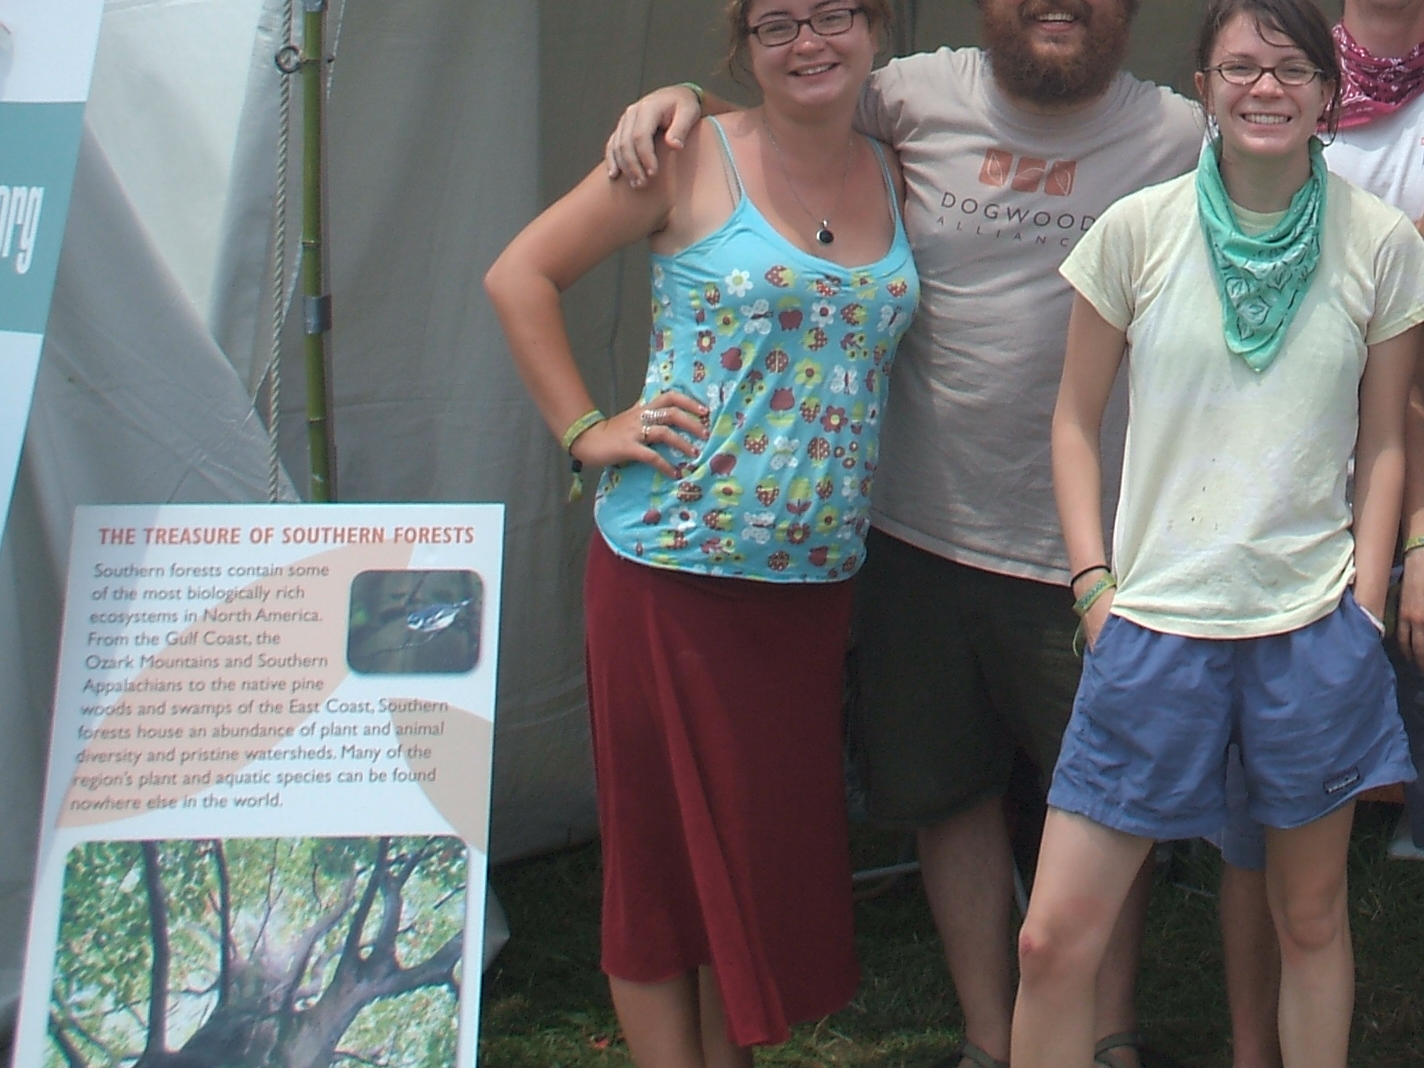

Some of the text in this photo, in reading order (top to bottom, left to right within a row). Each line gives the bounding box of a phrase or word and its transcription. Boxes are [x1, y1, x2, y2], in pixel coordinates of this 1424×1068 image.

[941, 192, 1095, 232] DOGWOOD
[99, 526, 475, 545] THE TREASURE OF SOUTHERN FORESTS
[94, 563, 329, 578] Southern forests contain some
[92, 585, 305, 603] of the most biologically rich
[90, 608, 323, 626] ecosystems in North America.
[87, 631, 281, 647] From the Gulf Coast, the
[86, 654, 329, 670] Ozark Mountains and Southern
[83, 678, 324, 696] Appalachians to the native pine
[81, 698, 449, 718] woods and swamps of the East Coast, Southern
[78, 721, 445, 739] forests house an abundance of plant and animal
[75, 743, 432, 766] diversity and pristine watersheds. Many of the
[72, 767, 437, 790] region's plant and aquatic species can be found
[70, 792, 283, 810] nowhere else in the world.
